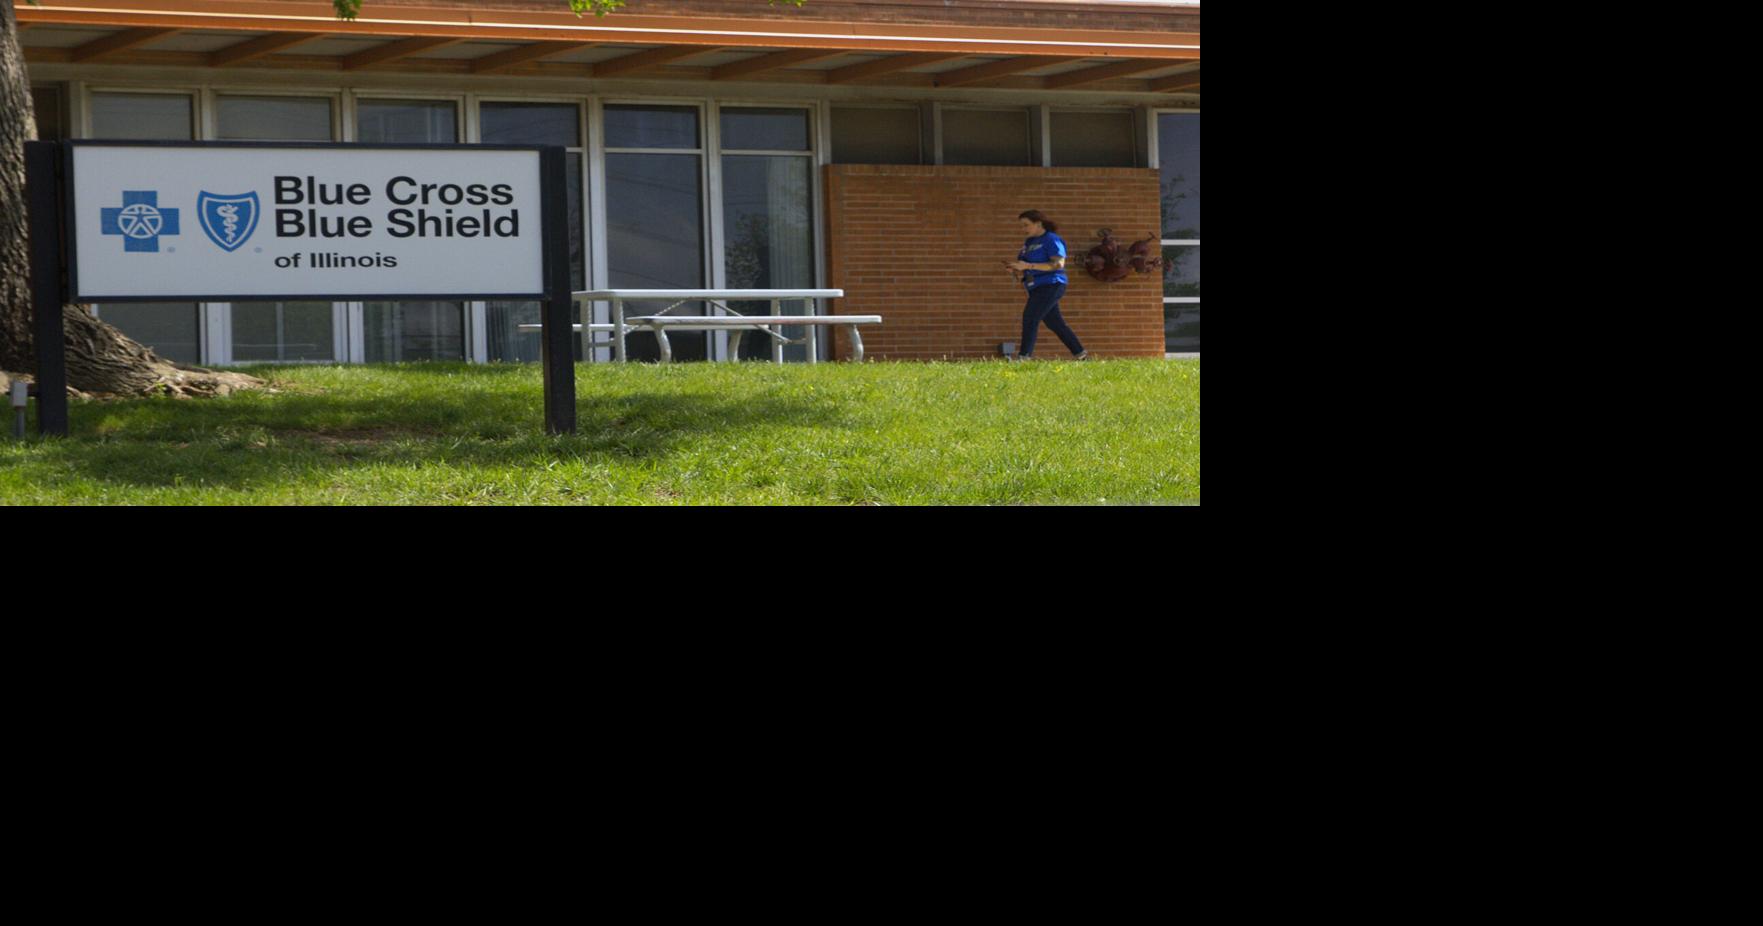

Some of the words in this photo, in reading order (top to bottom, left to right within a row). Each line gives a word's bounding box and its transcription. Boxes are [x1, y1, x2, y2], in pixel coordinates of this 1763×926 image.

[273, 175, 372, 206] Blue
[385, 175, 514, 206] Cross
[274, 208, 373, 239] Blue
[386, 207, 520, 239] Shield
[274, 252, 302, 269] of
[309, 252, 398, 269] Illinois
